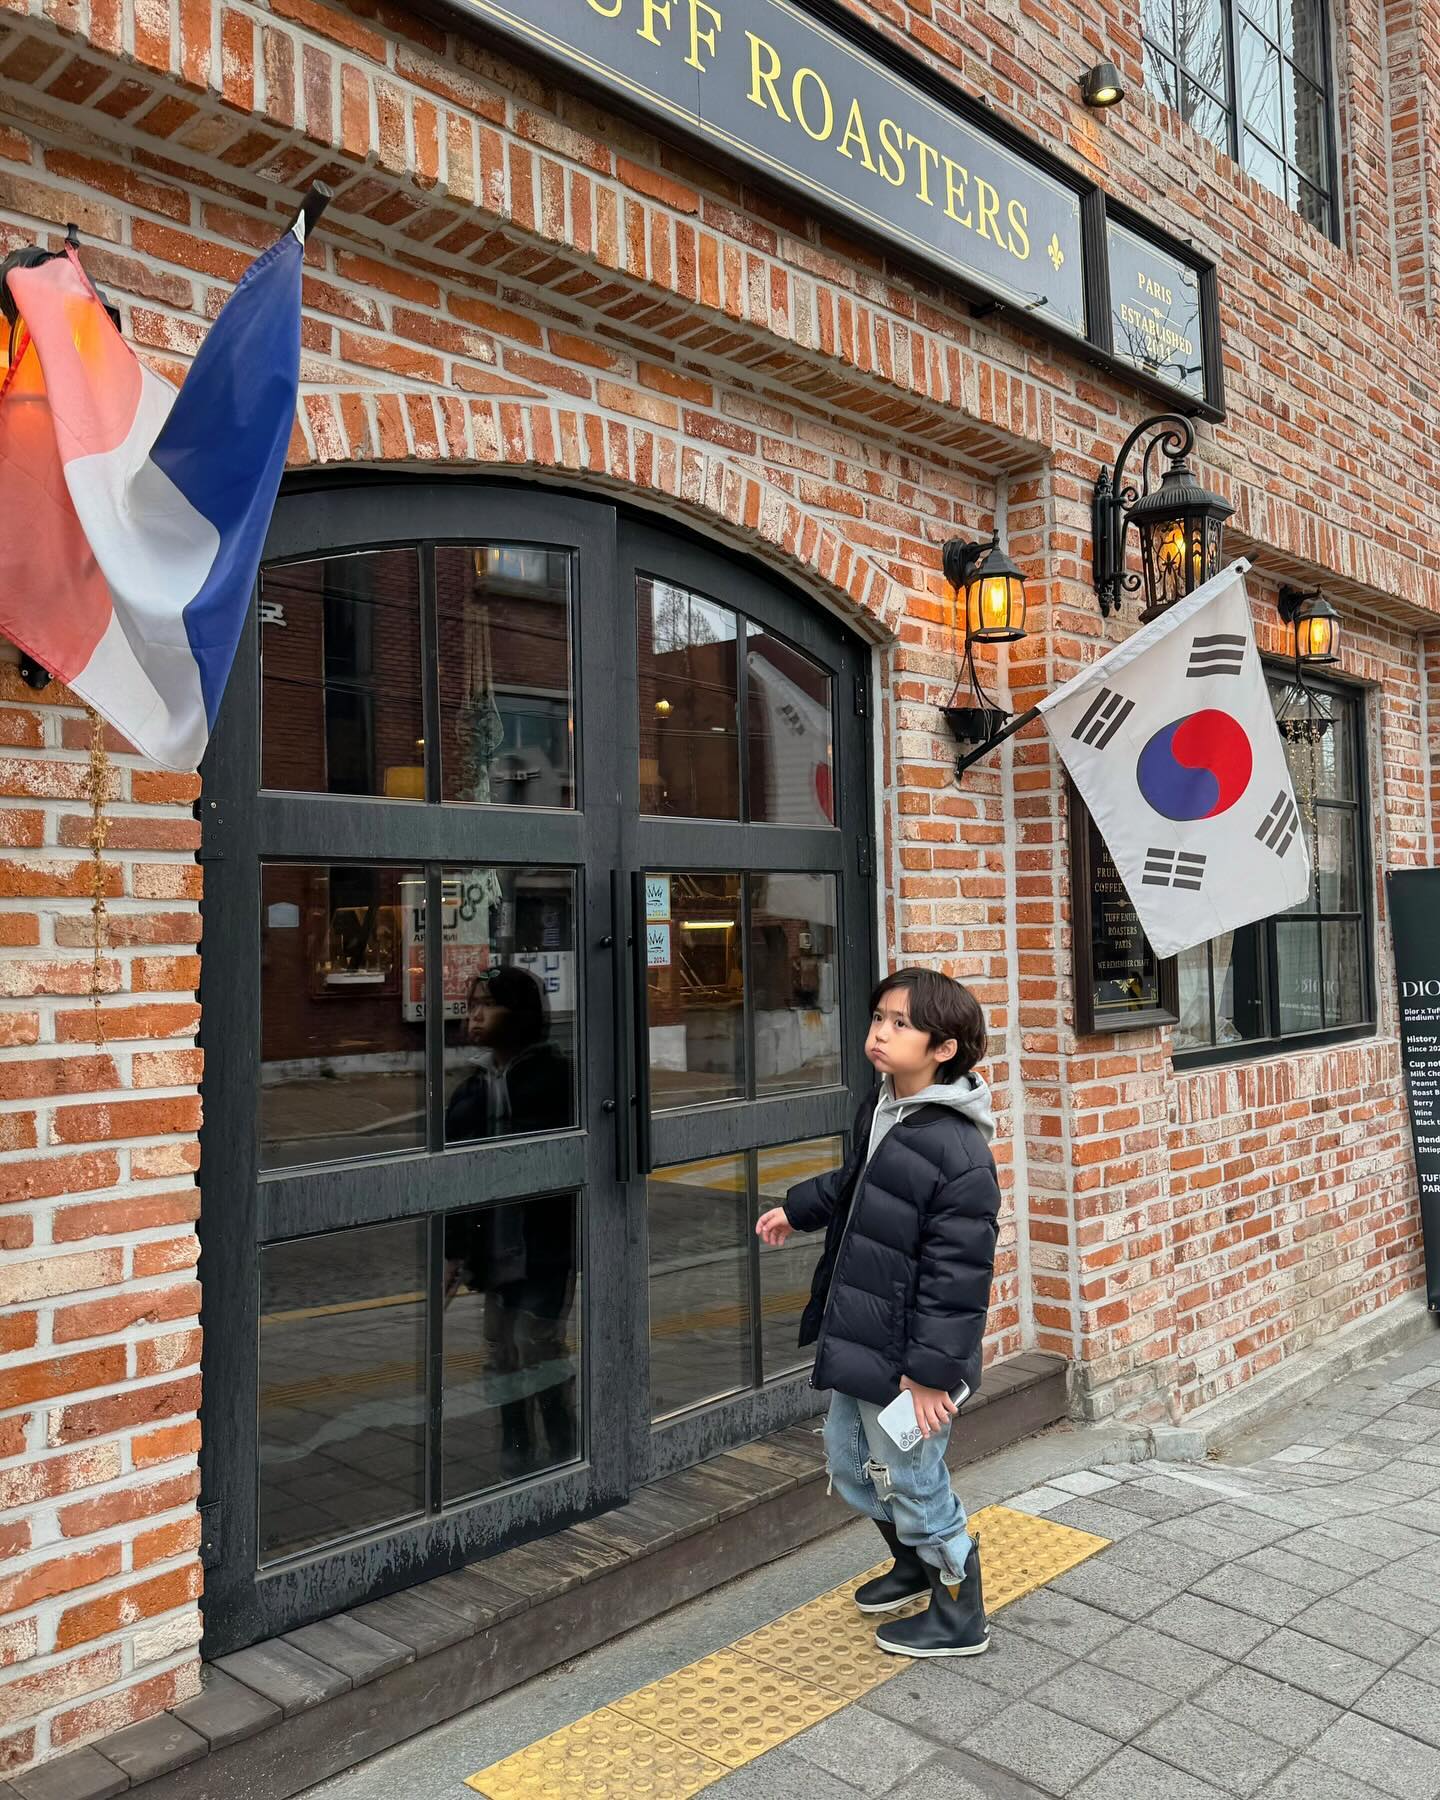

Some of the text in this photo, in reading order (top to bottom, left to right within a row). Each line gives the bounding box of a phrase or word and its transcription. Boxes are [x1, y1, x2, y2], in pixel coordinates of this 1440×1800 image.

[584, 0, 1030, 260] FF ROASTERS
[1138, 271, 1172, 305] PARIS
[1120, 303, 1193, 356] ESTABLISHED
[1094, 882, 1123, 893] COFFEE
[1107, 926, 1138, 937] ROASTERS
[1404, 1008, 1420, 1016] Dior
[1406, 1035, 1437, 1044] History
[1407, 1045, 1427, 1053] Since
[1409, 1060, 1426, 1069] Cup
[1410, 1070, 1426, 1078] Milk
[1413, 1100, 1433, 1108] Berry
[1414, 1109, 1433, 1117] Wine
[1416, 1119, 1436, 1127] Black
